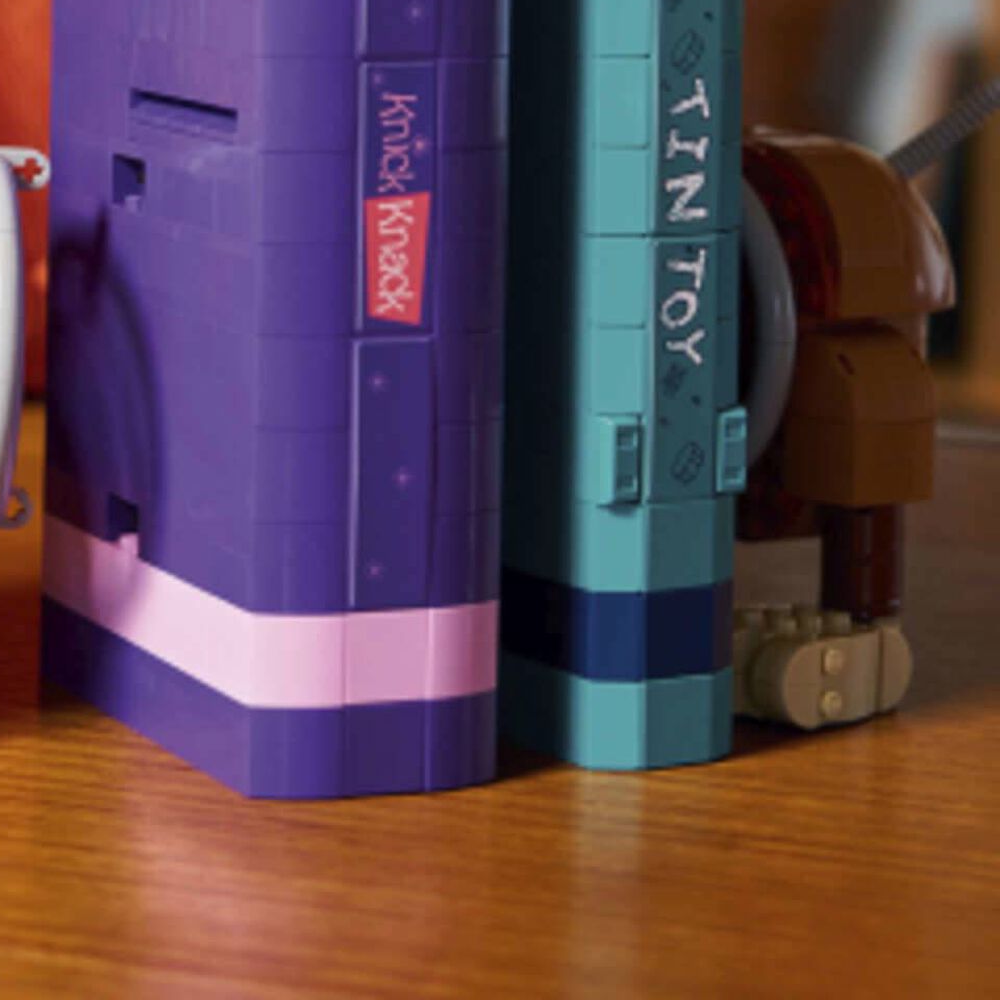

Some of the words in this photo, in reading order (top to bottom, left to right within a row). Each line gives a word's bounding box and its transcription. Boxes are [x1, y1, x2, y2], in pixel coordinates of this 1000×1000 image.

[378, 92, 423, 193] Knick
[665, 77, 711, 223] TIN
[375, 198, 415, 316] Knack
[660, 247, 707, 366] TOY
